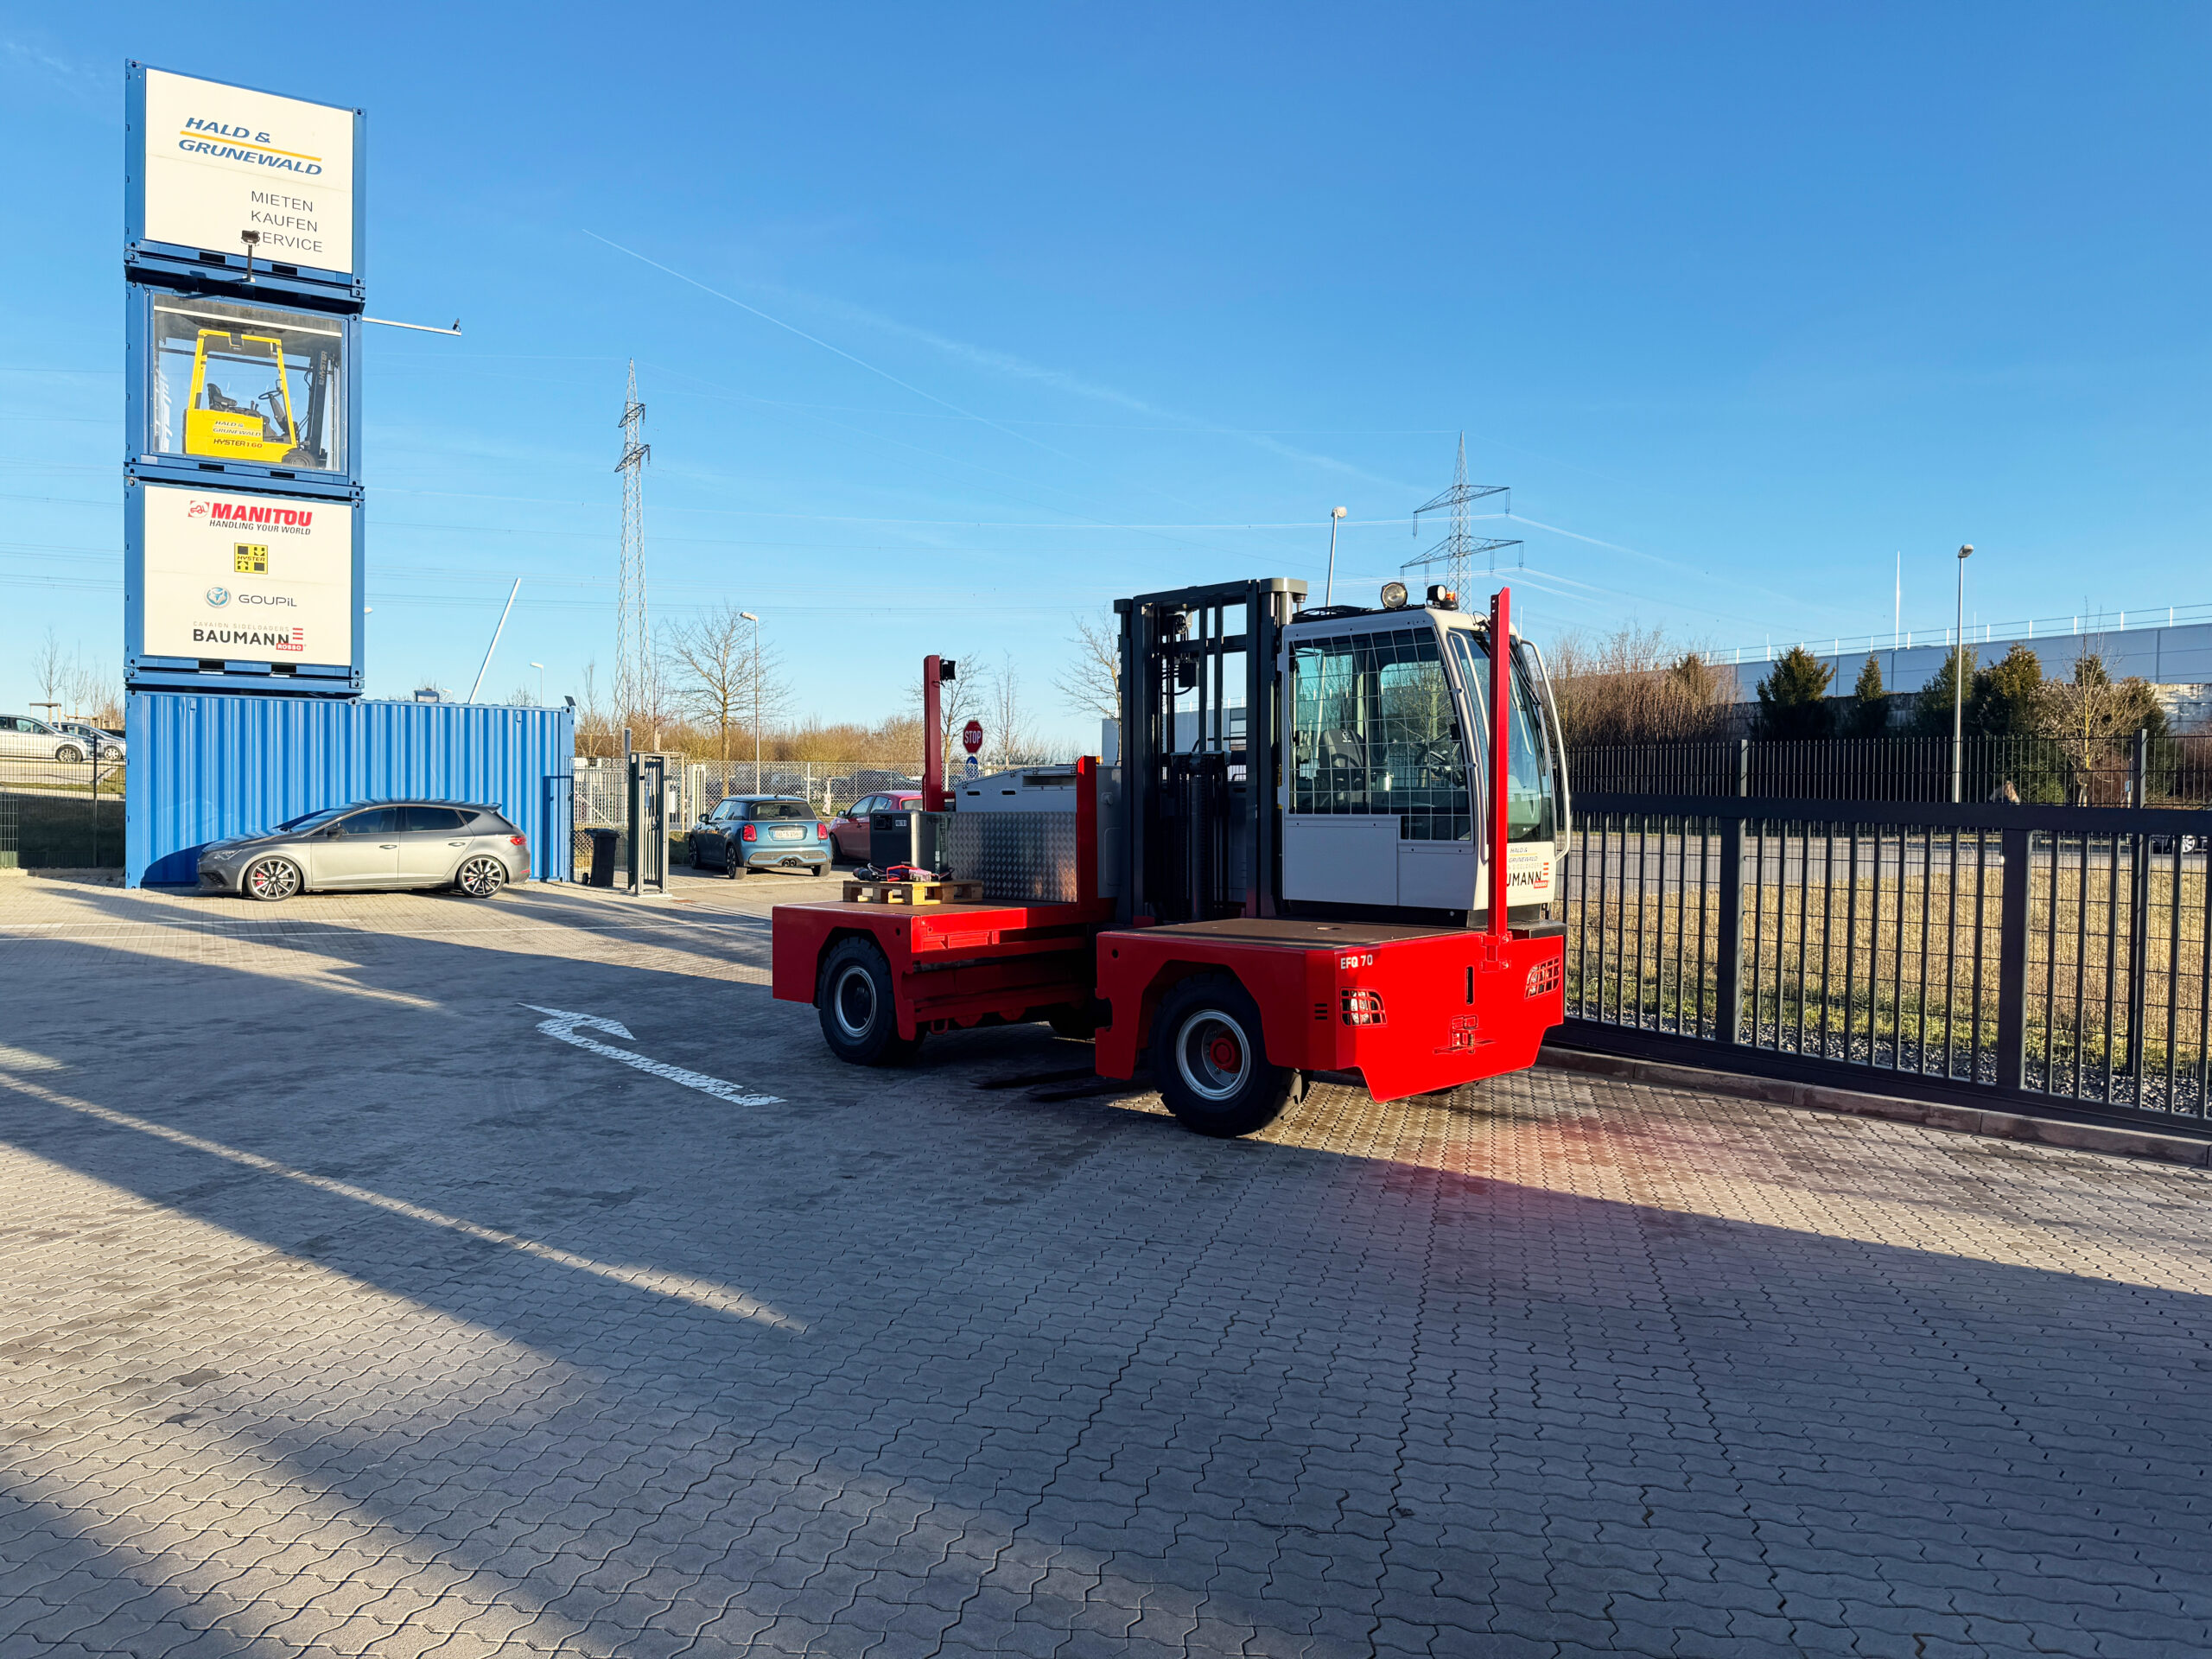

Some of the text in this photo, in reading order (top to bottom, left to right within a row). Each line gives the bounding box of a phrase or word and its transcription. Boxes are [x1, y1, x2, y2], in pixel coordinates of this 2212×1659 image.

[185, 117, 271, 144] HALD &
[178, 138, 322, 176] GRUNEWALD
[251, 190, 314, 213] MIETEN
[251, 210, 318, 232] KAUFEN
[213, 428, 261, 436] GRUNEWALD
[213, 438, 245, 447] HYSTER
[211, 502, 313, 527] MANITOU
[209, 519, 311, 536] HANDLING YOUR WORLD
[232, 623, 289, 632] SIDELOADERS
[193, 628, 289, 646] BAUMANN
[965, 730, 981, 744] STOP
[1340, 954, 1373, 969] EFQ 70
